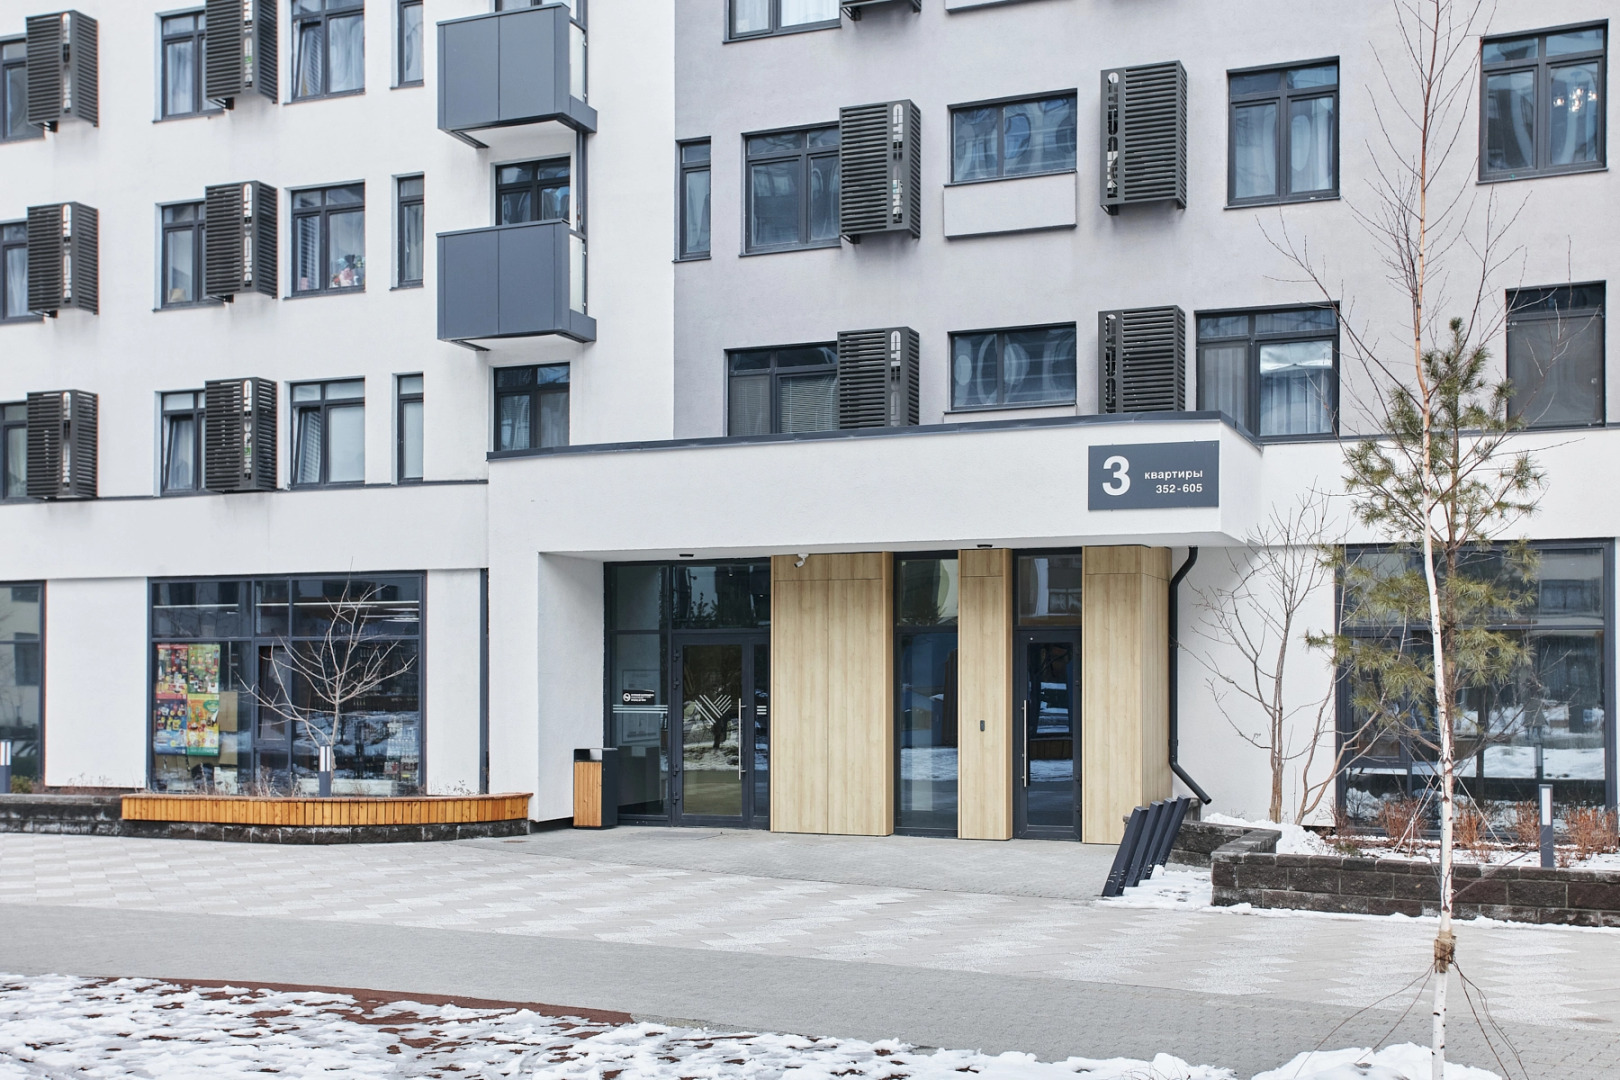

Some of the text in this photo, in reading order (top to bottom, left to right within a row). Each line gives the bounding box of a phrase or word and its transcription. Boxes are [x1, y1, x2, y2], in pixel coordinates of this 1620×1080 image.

[1102, 455, 1131, 496] 3
[1144, 470, 1203, 481] квартиры
[1156, 483, 1203, 494] 352-605
